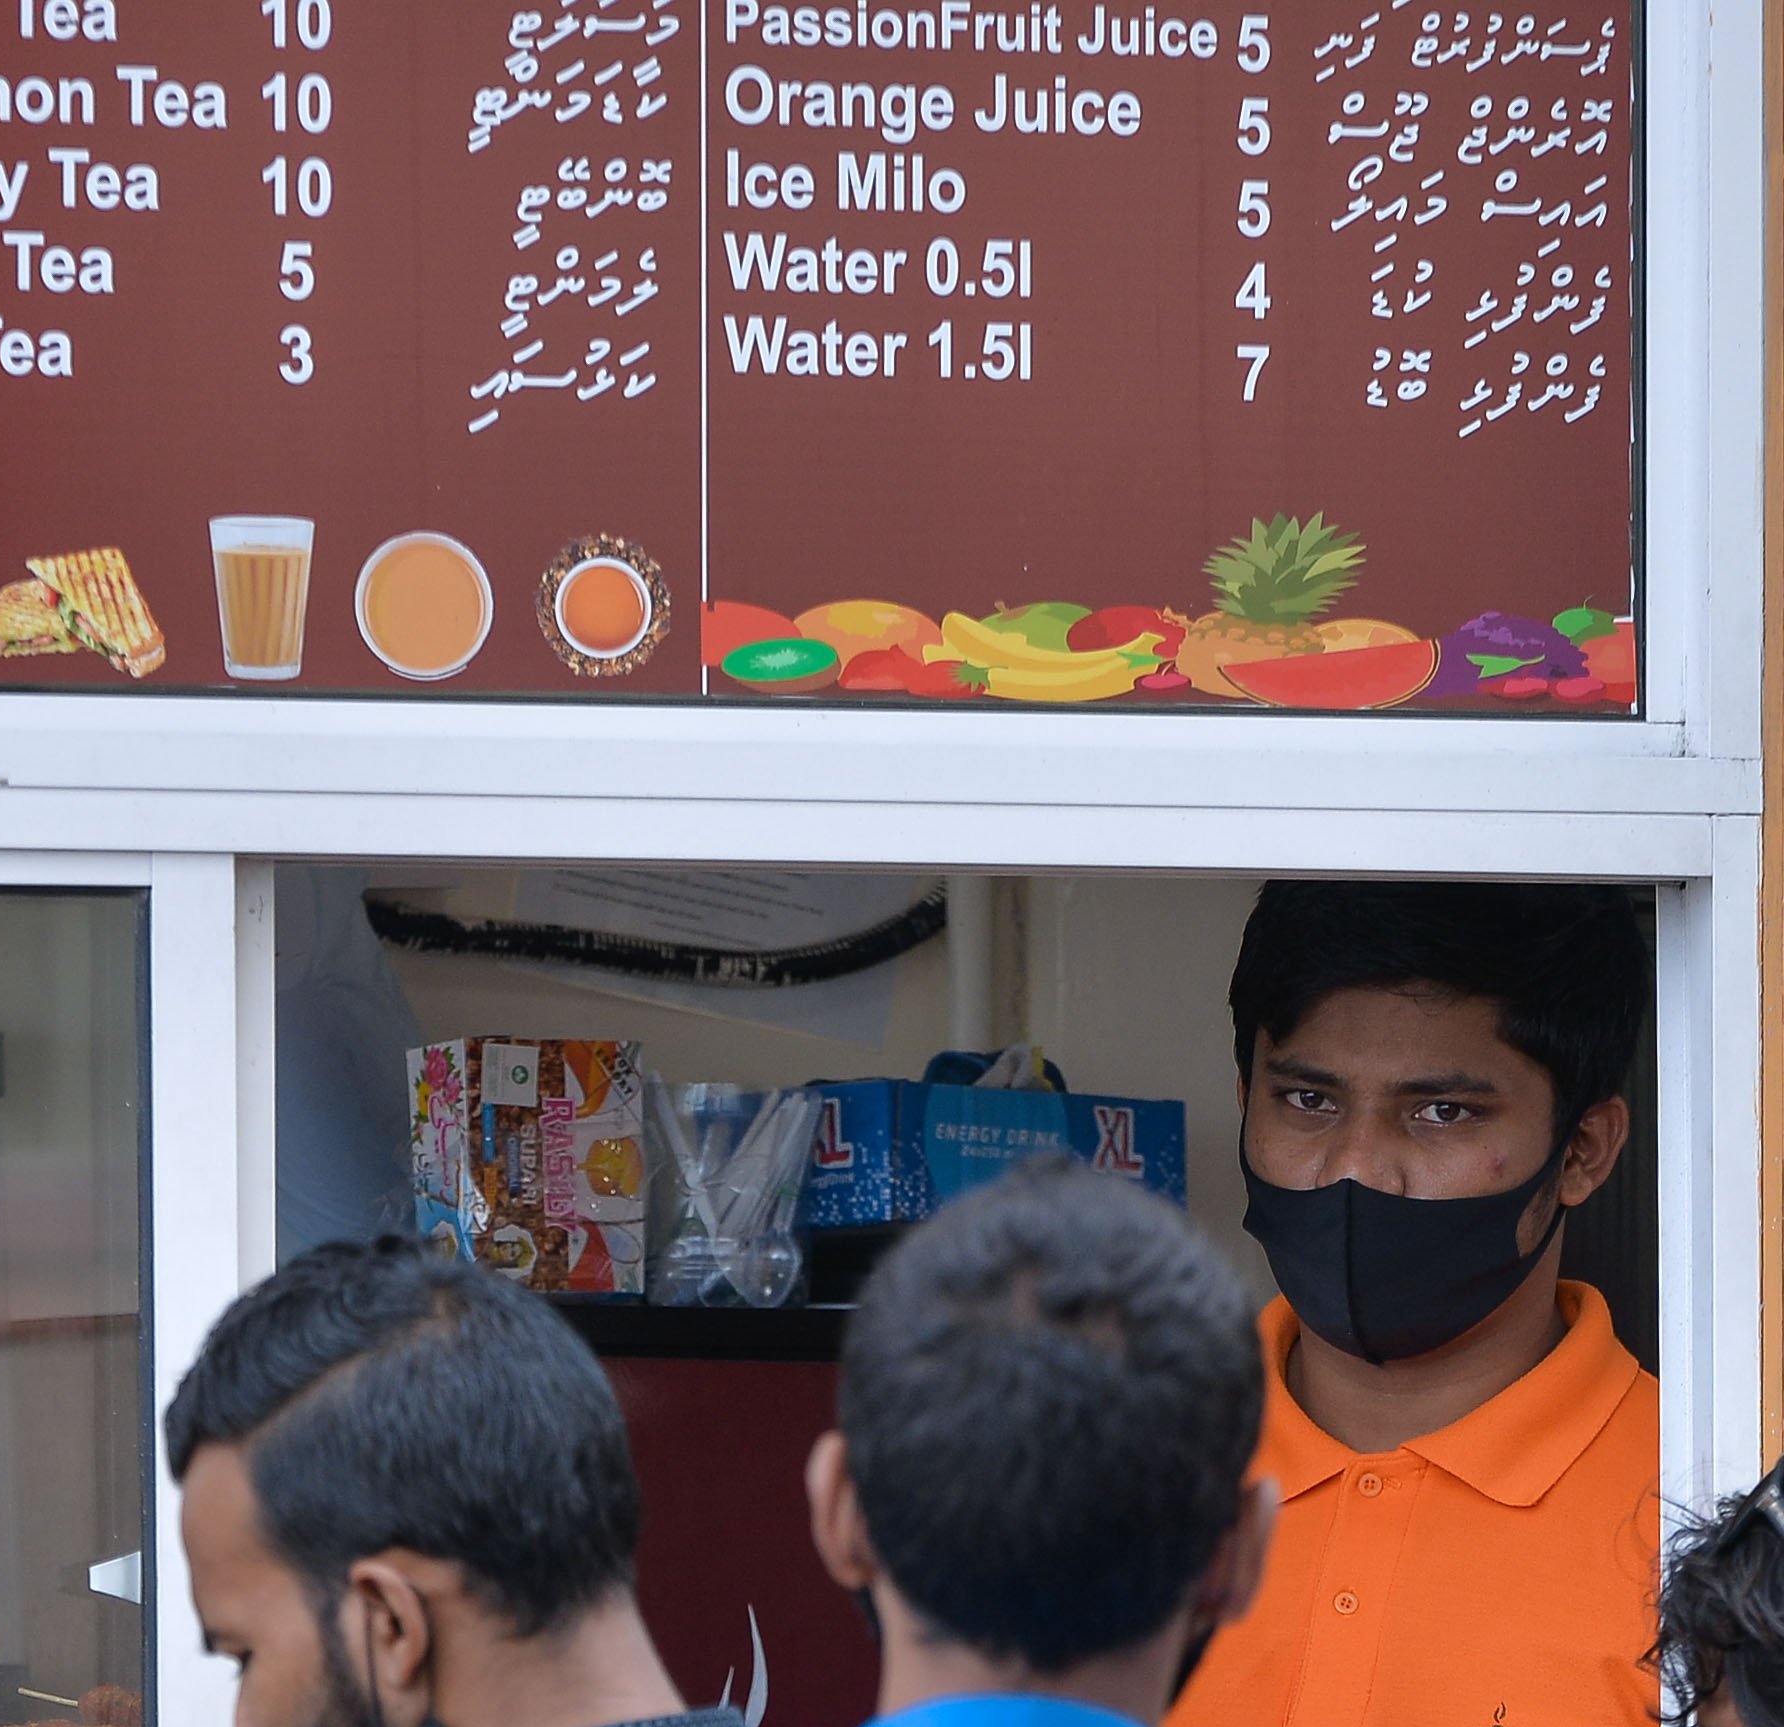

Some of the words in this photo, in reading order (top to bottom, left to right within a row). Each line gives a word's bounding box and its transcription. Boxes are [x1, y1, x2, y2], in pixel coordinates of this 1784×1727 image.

[19, 0, 118, 42] Tea
[260, 0, 332, 50] 10
[725, 0, 1063, 54] PassionFruit
[1076, 4, 1219, 59] Juice
[1236, 14, 1272, 74] 5
[115, 65, 228, 129] Tea
[261, 72, 333, 134] 10
[724, 65, 955, 145] Orange
[973, 73, 1142, 137] Juice
[1236, 97, 1272, 156] 5
[47, 147, 160, 211] Tea
[261, 156, 333, 218] 10
[726, 148, 816, 210] Ice
[837, 151, 967, 214] Milo
[1236, 180, 1272, 239] 5
[2, 231, 115, 294] Tea
[278, 241, 316, 301] 5
[722, 231, 908, 295] Water
[1234, 261, 1272, 320] 4
[278, 324, 315, 385] 3
[722, 314, 909, 378] Water
[1236, 344, 1271, 402] 7
[519, 1123, 537, 1205] SUPARI
[935, 1123, 1002, 1143] ENERGY
[1093, 1105, 1145, 1179] XL
